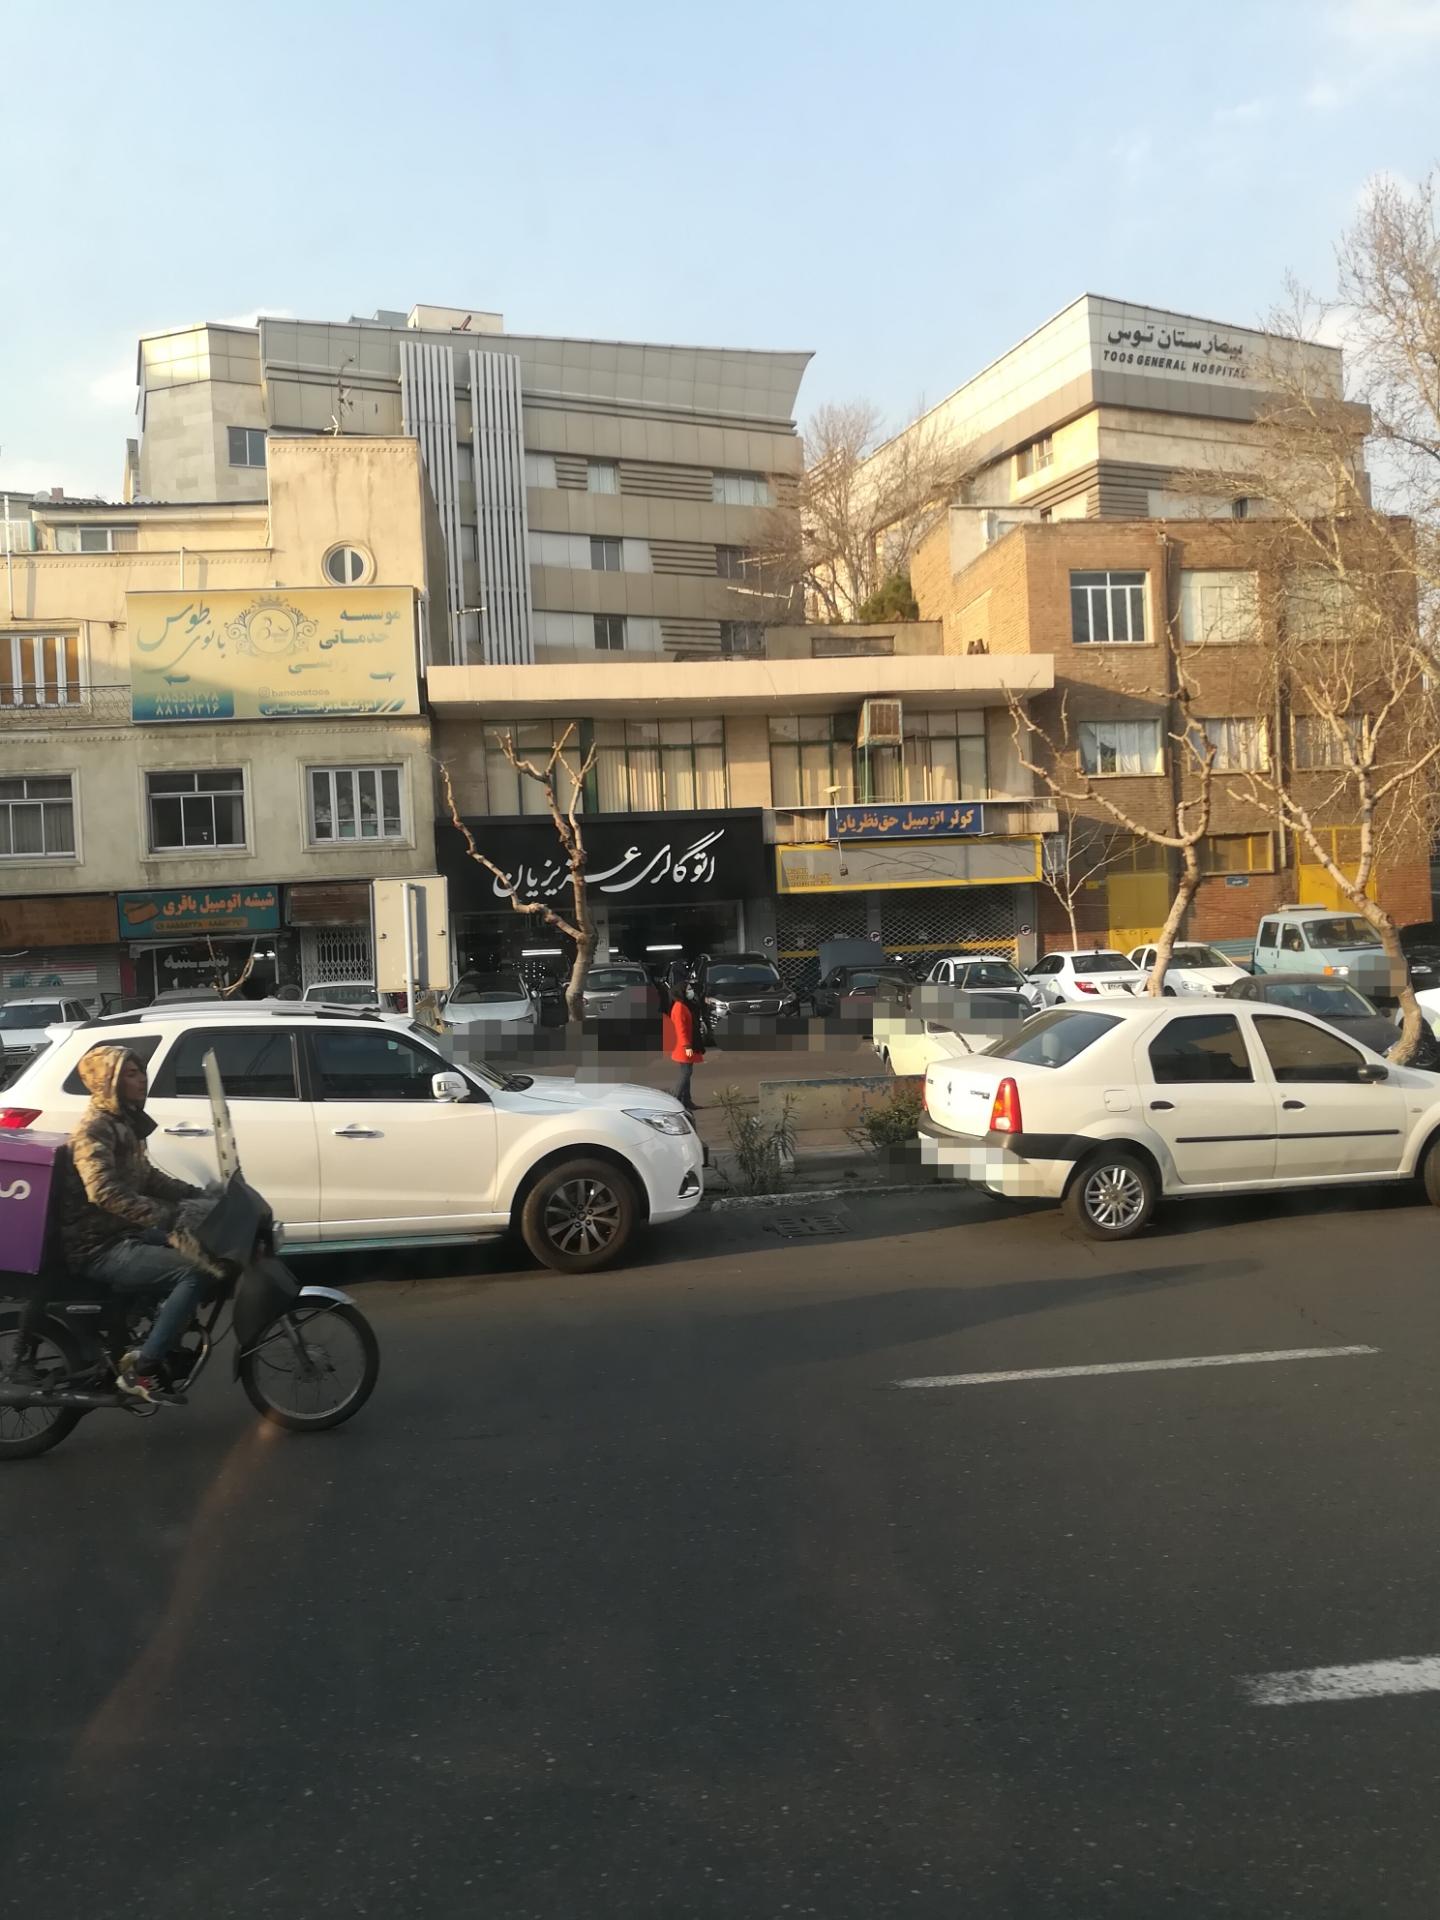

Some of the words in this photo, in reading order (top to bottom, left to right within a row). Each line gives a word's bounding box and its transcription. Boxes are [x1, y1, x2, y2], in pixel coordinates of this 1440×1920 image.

[1107, 324, 1154, 347] توس
[1158, 329, 1244, 360] بیمارستان
[1103, 350, 1134, 364] TOOS
[1136, 355, 1187, 371] GENERAL
[1191, 364, 1248, 379] HOSPITAL
[902, 809, 945, 831] اتومبیل
[162, 894, 197, 916] باقری
[200, 893, 242, 913] اتومبیل
[244, 892, 275, 910] شیشه
